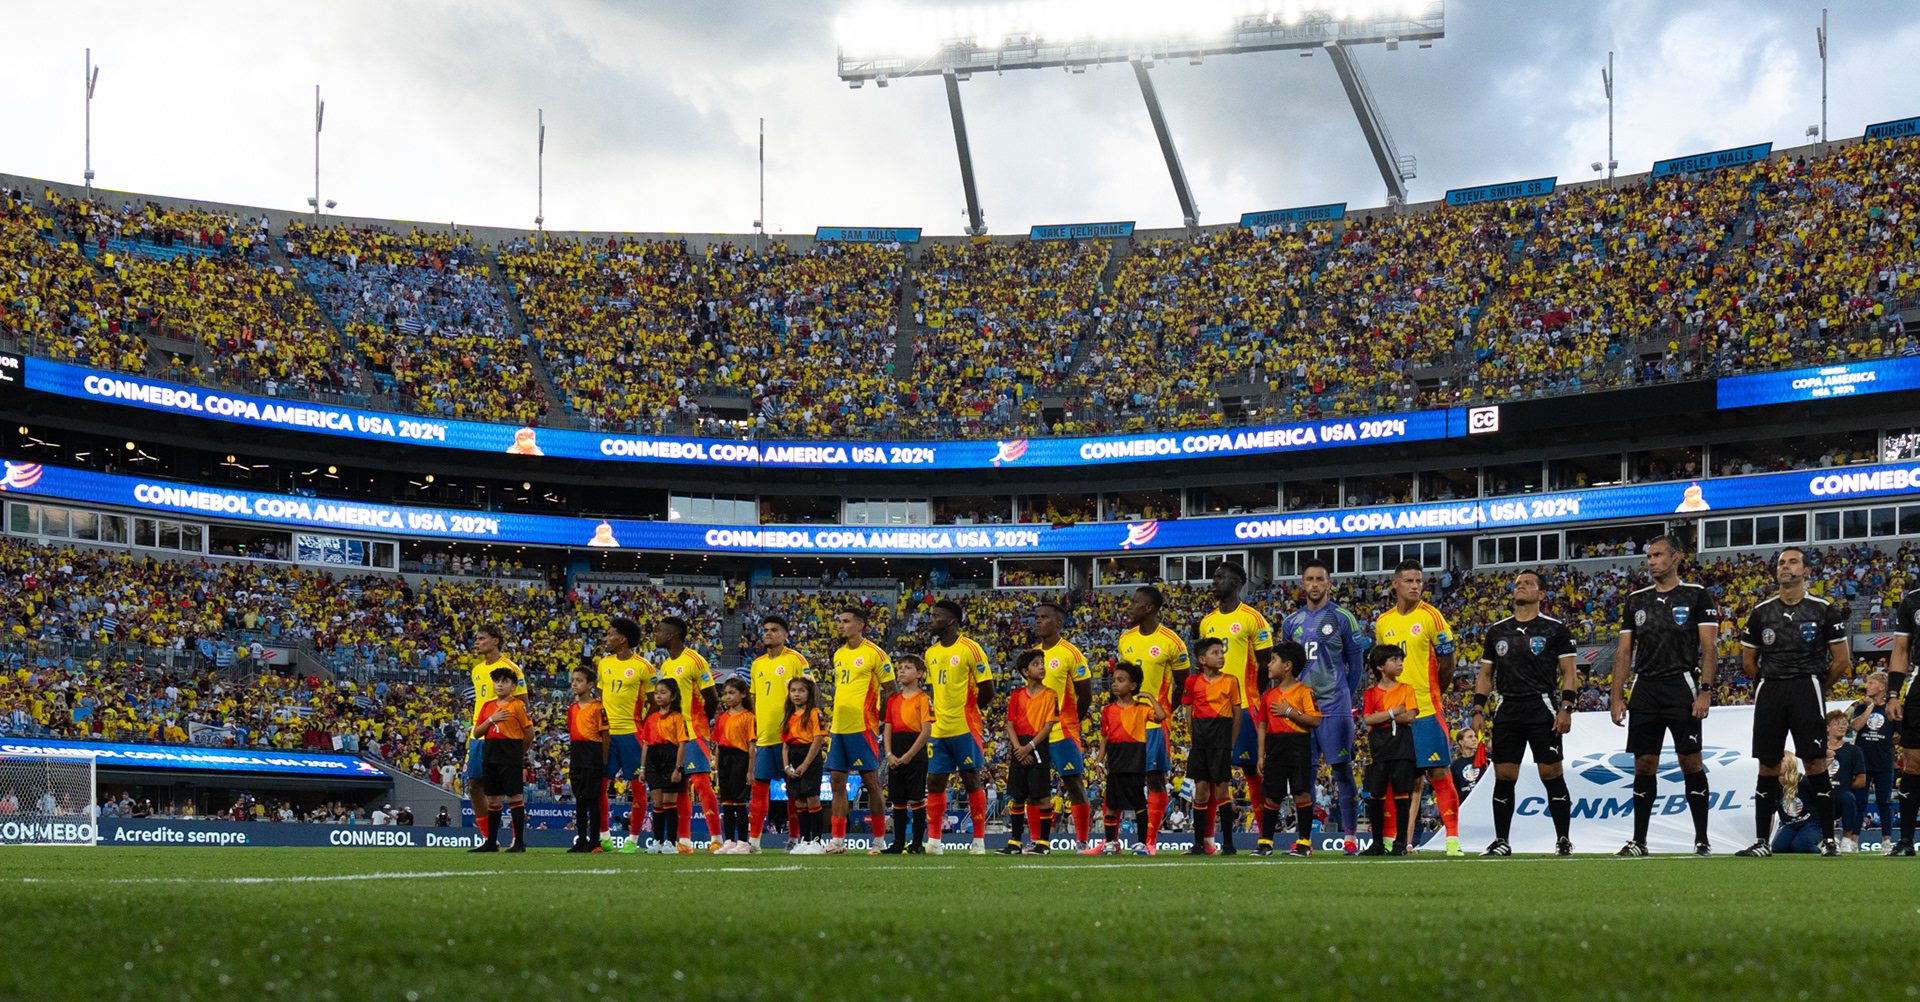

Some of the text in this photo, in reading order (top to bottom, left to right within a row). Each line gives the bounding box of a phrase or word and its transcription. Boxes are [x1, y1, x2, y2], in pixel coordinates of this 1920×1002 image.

[1871, 121, 1916, 138] MUHSIN
[1669, 149, 1754, 173] WESLEY WALLS
[1455, 182, 1545, 203] STEVE SMITH SR.
[1255, 207, 1331, 226] JORDAN GROSS
[840, 229, 897, 241] SAM MILLS
[1041, 223, 1124, 239] JAKE DELHOMME
[1792, 377, 1823, 389] COPA
[1824, 371, 1876, 386] AMERICA
[84, 375, 446, 441] CONMEBOL COPA AMERICA USA 2024
[1472, 411, 1495, 429] CC
[1080, 419, 1406, 460] CONMEBOL COPA AMERICA USA 2024
[600, 438, 935, 464] CONMEBOL COPA AMERICA USA 2024
[134, 483, 499, 535] CONMEBOL COPA AMERICA USA 2024
[1235, 498, 1580, 540] CONMEBOL COPA AMERICA USA 2024
[705, 528, 1040, 549] CONMEBOL COPA AMERICA USA 2024
[1305, 641, 1318, 660] 12
[840, 669, 850, 684] 21
[938, 669, 947, 685] 16
[480, 684, 487, 698] 6
[611, 679, 623, 693] 17
[765, 681, 771, 696] 7
[528, 808, 563, 817] AMERICA
[0, 822, 104, 841] ONMEBOL
[114, 825, 185, 843] Acredite
[330, 829, 415, 846] CONMEBOL
[426, 833, 463, 847] Dream
[1157, 841, 1195, 850] ream
